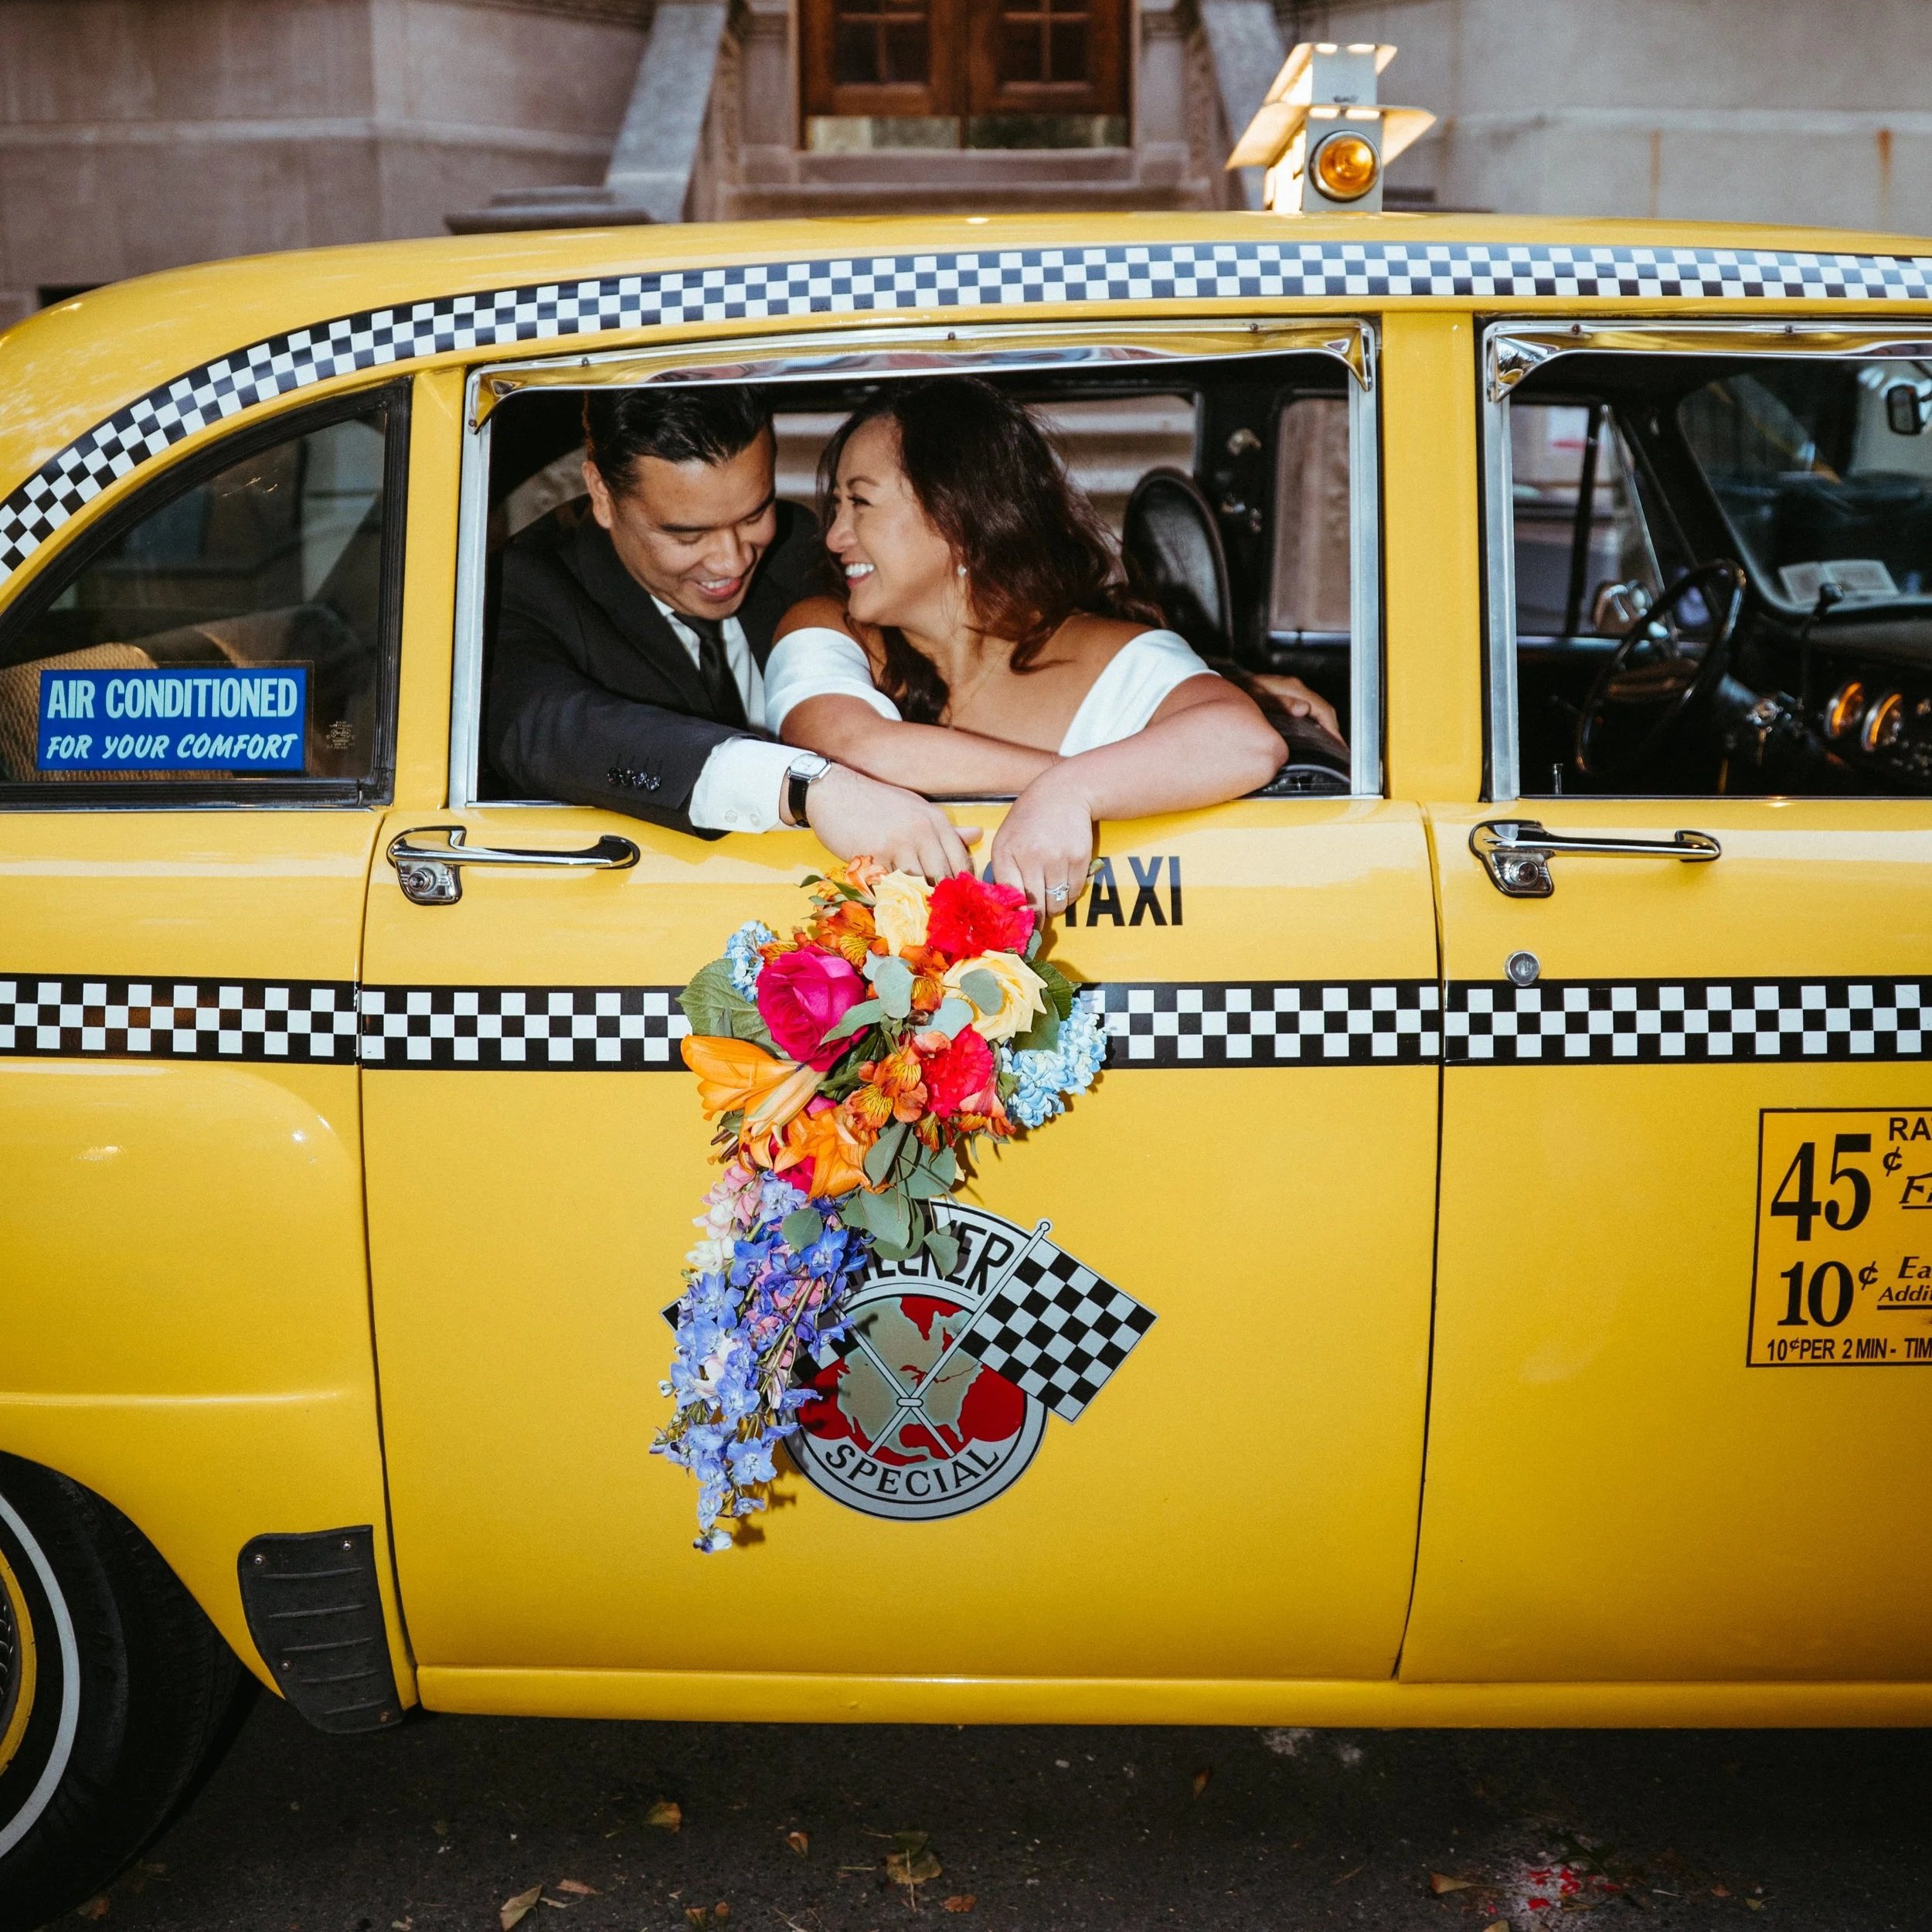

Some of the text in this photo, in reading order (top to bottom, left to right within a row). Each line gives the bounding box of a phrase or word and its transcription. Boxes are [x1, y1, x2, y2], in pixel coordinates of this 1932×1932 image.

[47, 677, 298, 719] AIR CONDITIONED
[46, 734, 90, 760] FOR
[101, 734, 166, 760] YOUR
[176, 733, 299, 759] COMFORT
[825, 1443, 1000, 1498] SPECIAL
